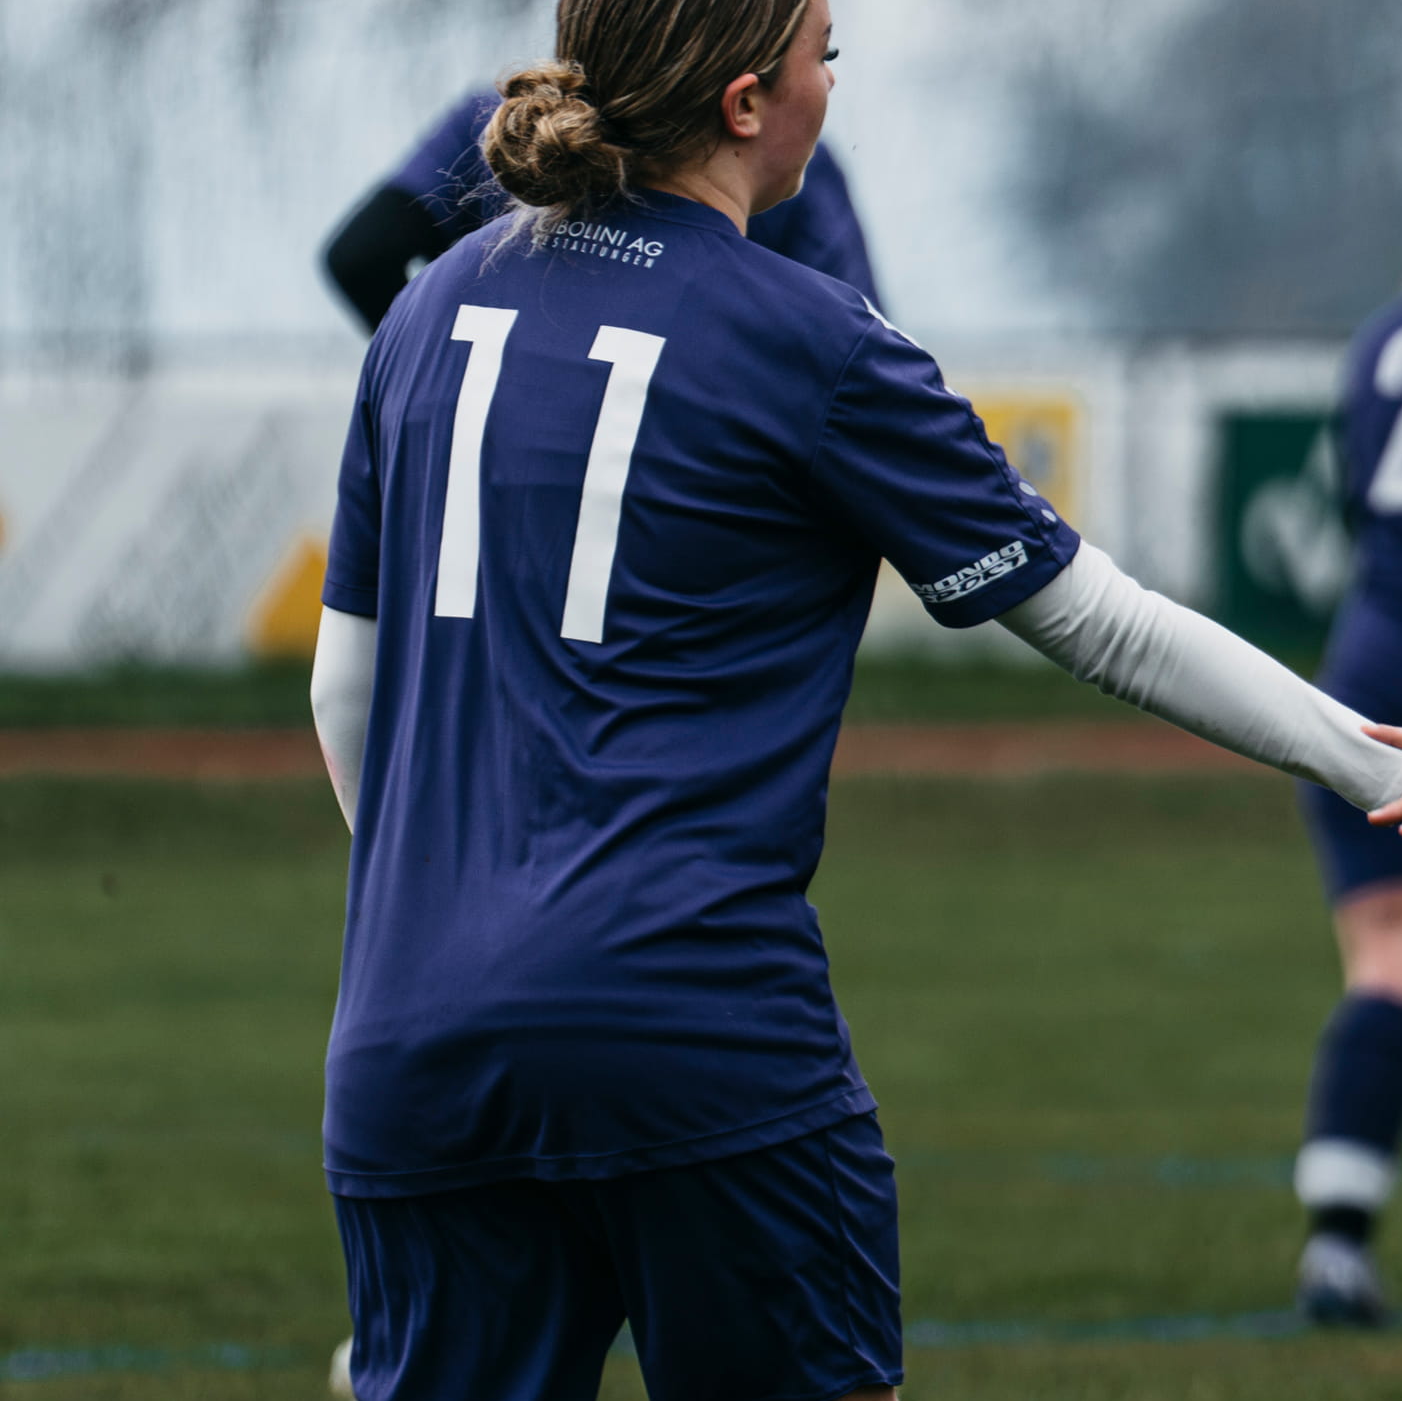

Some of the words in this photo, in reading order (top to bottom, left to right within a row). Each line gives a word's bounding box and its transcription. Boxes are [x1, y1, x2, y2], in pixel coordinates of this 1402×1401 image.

[627, 237, 664, 257] AG
[434, 304, 666, 644] 11
[911, 540, 1024, 592] MONDO
